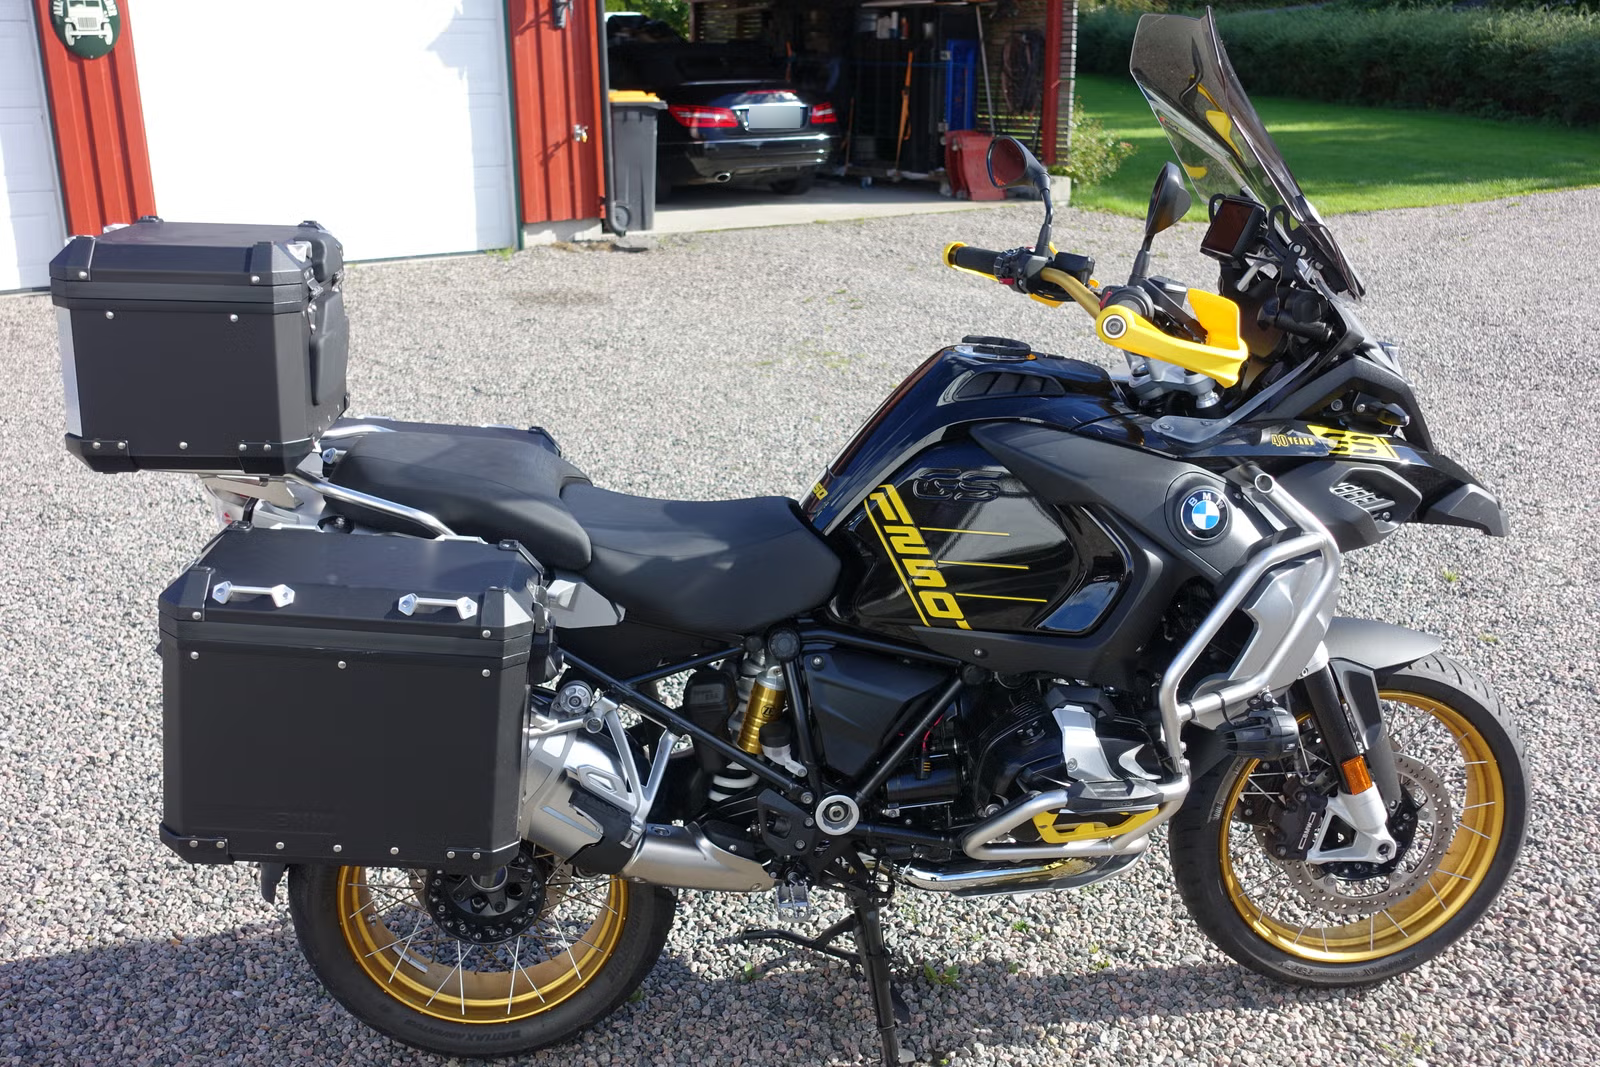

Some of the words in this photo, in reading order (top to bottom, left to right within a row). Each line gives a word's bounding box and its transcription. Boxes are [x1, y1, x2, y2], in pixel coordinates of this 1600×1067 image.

[1271, 433, 1288, 447] 40
[1287, 435, 1315, 447] YEARS
[1187, 492, 1226, 510] BMW
